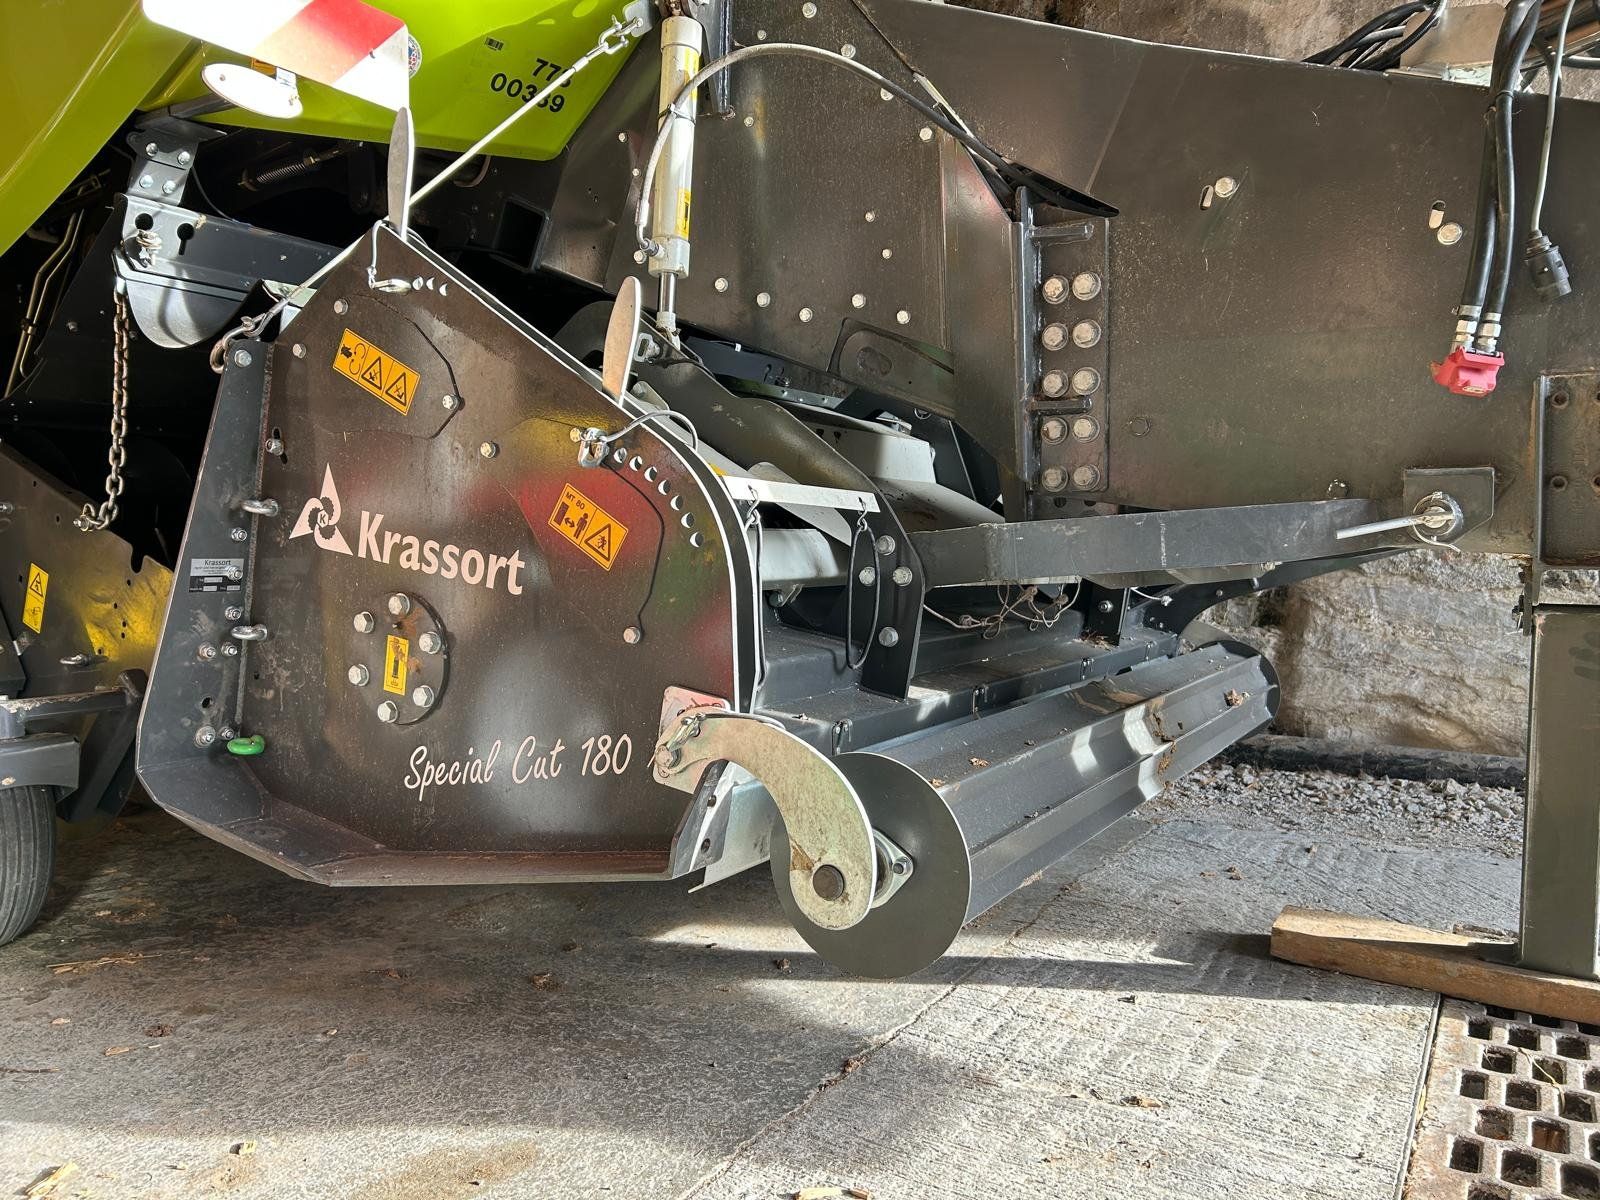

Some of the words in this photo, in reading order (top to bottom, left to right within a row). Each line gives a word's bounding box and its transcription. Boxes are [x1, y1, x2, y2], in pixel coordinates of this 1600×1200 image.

[565, 491, 575, 502] MT
[575, 499, 585, 510] 80
[319, 513, 326, 525] K
[358, 510, 526, 595] Krassort
[404, 739, 501, 801] Special
[512, 735, 565, 784] Cut
[581, 733, 632, 776] 180
